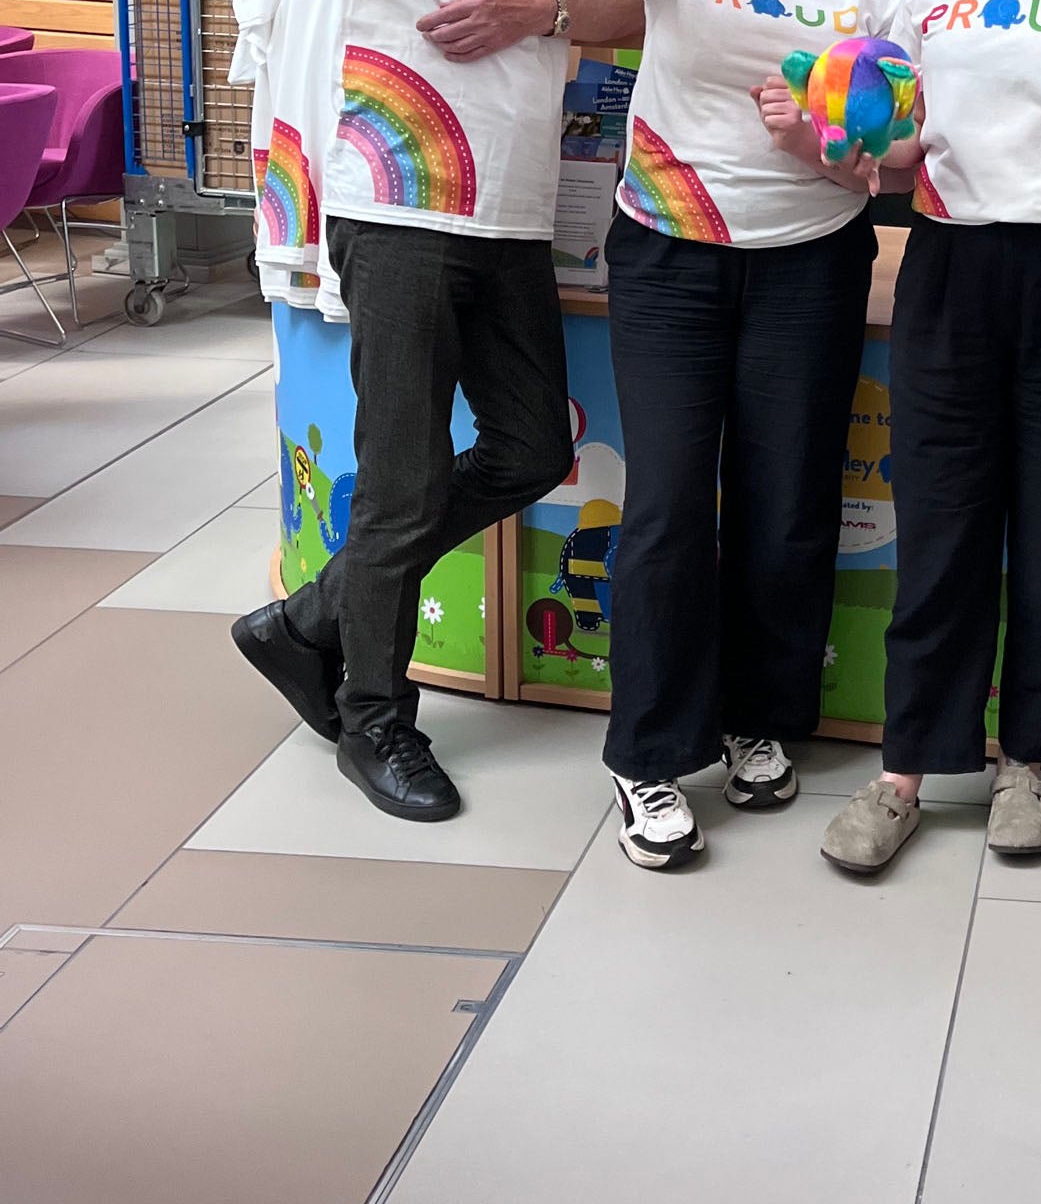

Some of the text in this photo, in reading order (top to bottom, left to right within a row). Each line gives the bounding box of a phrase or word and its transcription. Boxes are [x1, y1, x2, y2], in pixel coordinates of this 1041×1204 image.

[604, 77, 628, 86] London
[592, 96, 616, 104] London
[600, 102, 629, 110] Amsterd
